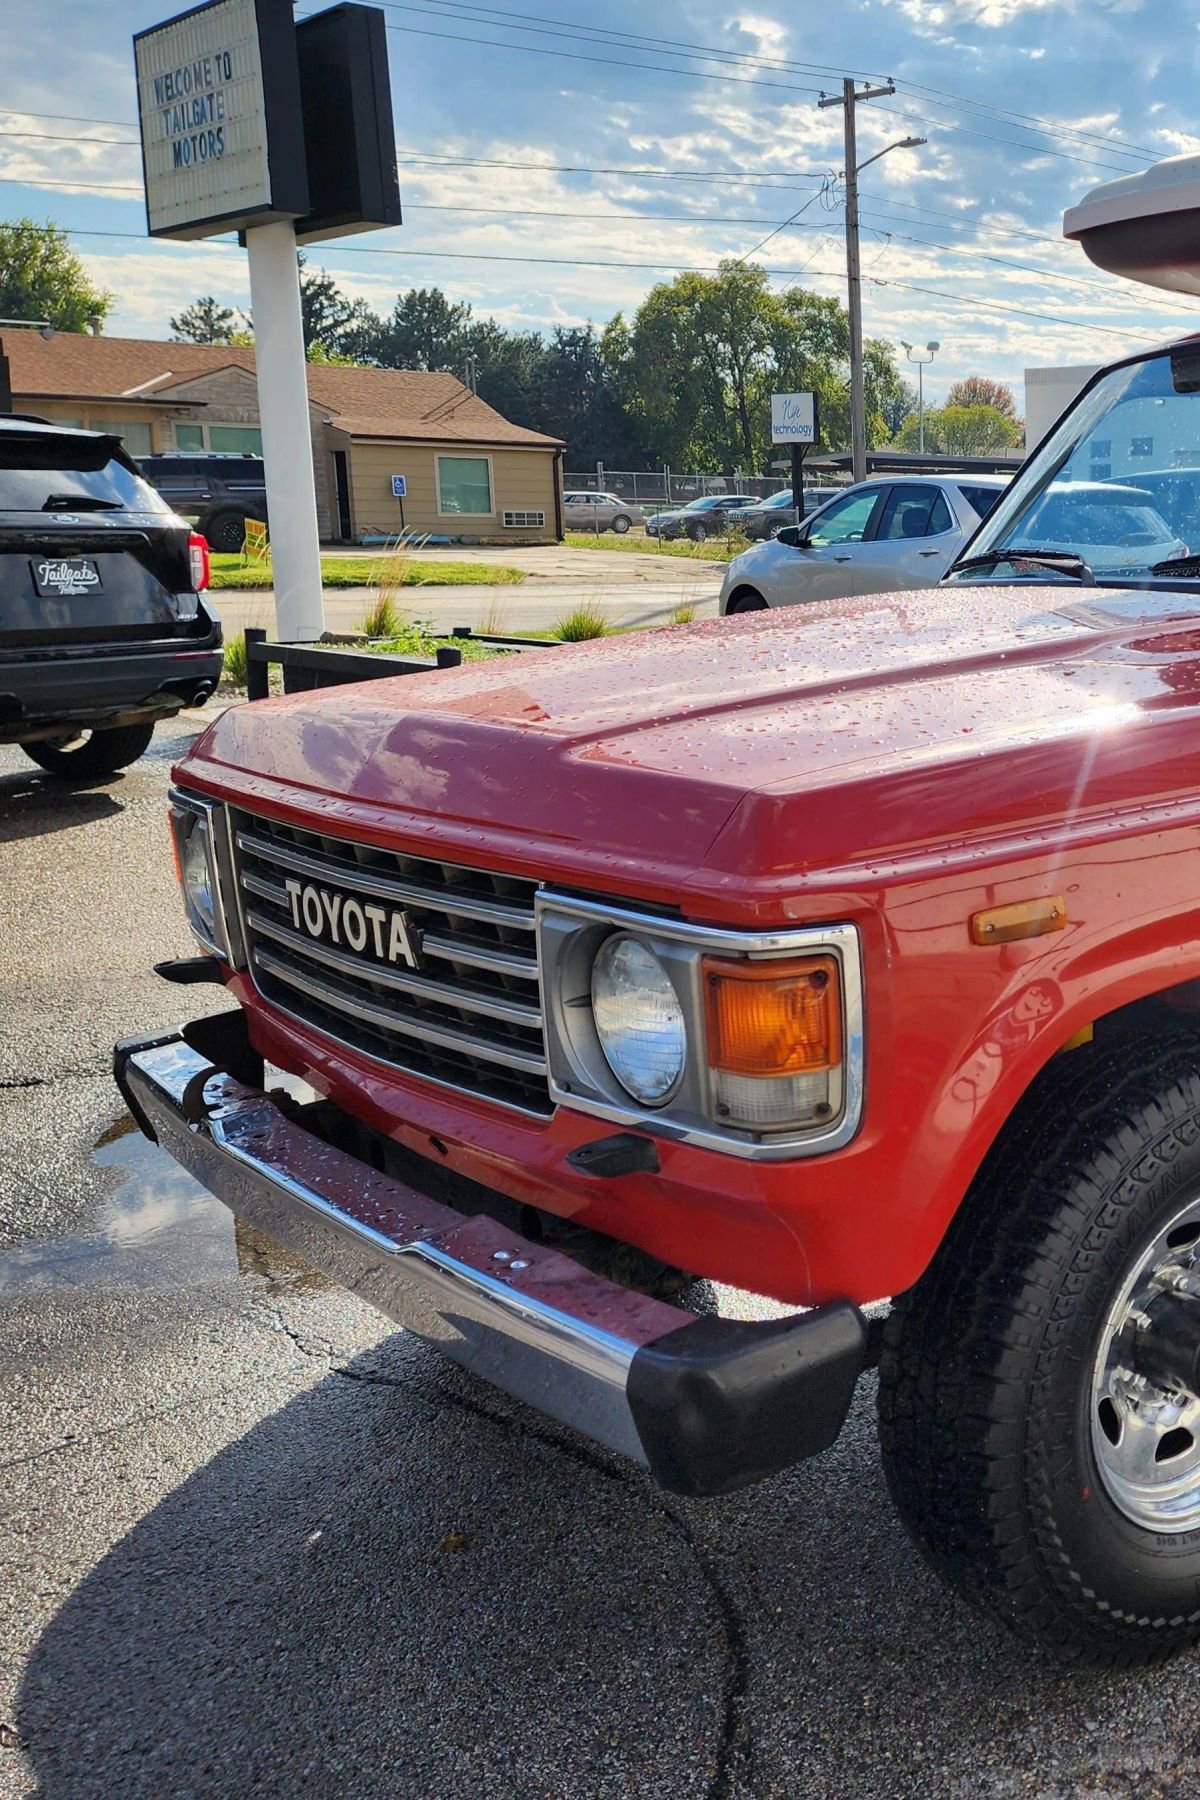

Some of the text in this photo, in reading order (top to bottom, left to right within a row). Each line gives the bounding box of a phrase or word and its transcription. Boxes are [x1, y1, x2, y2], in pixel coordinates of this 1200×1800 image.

[154, 52, 232, 106] WELCOME TO
[163, 89, 225, 136] TAILGATE
[173, 127, 225, 168] MOTORS
[773, 423, 813, 437] technology
[39, 561, 99, 586] Tailgate
[285, 879, 418, 969] TOYOTA
